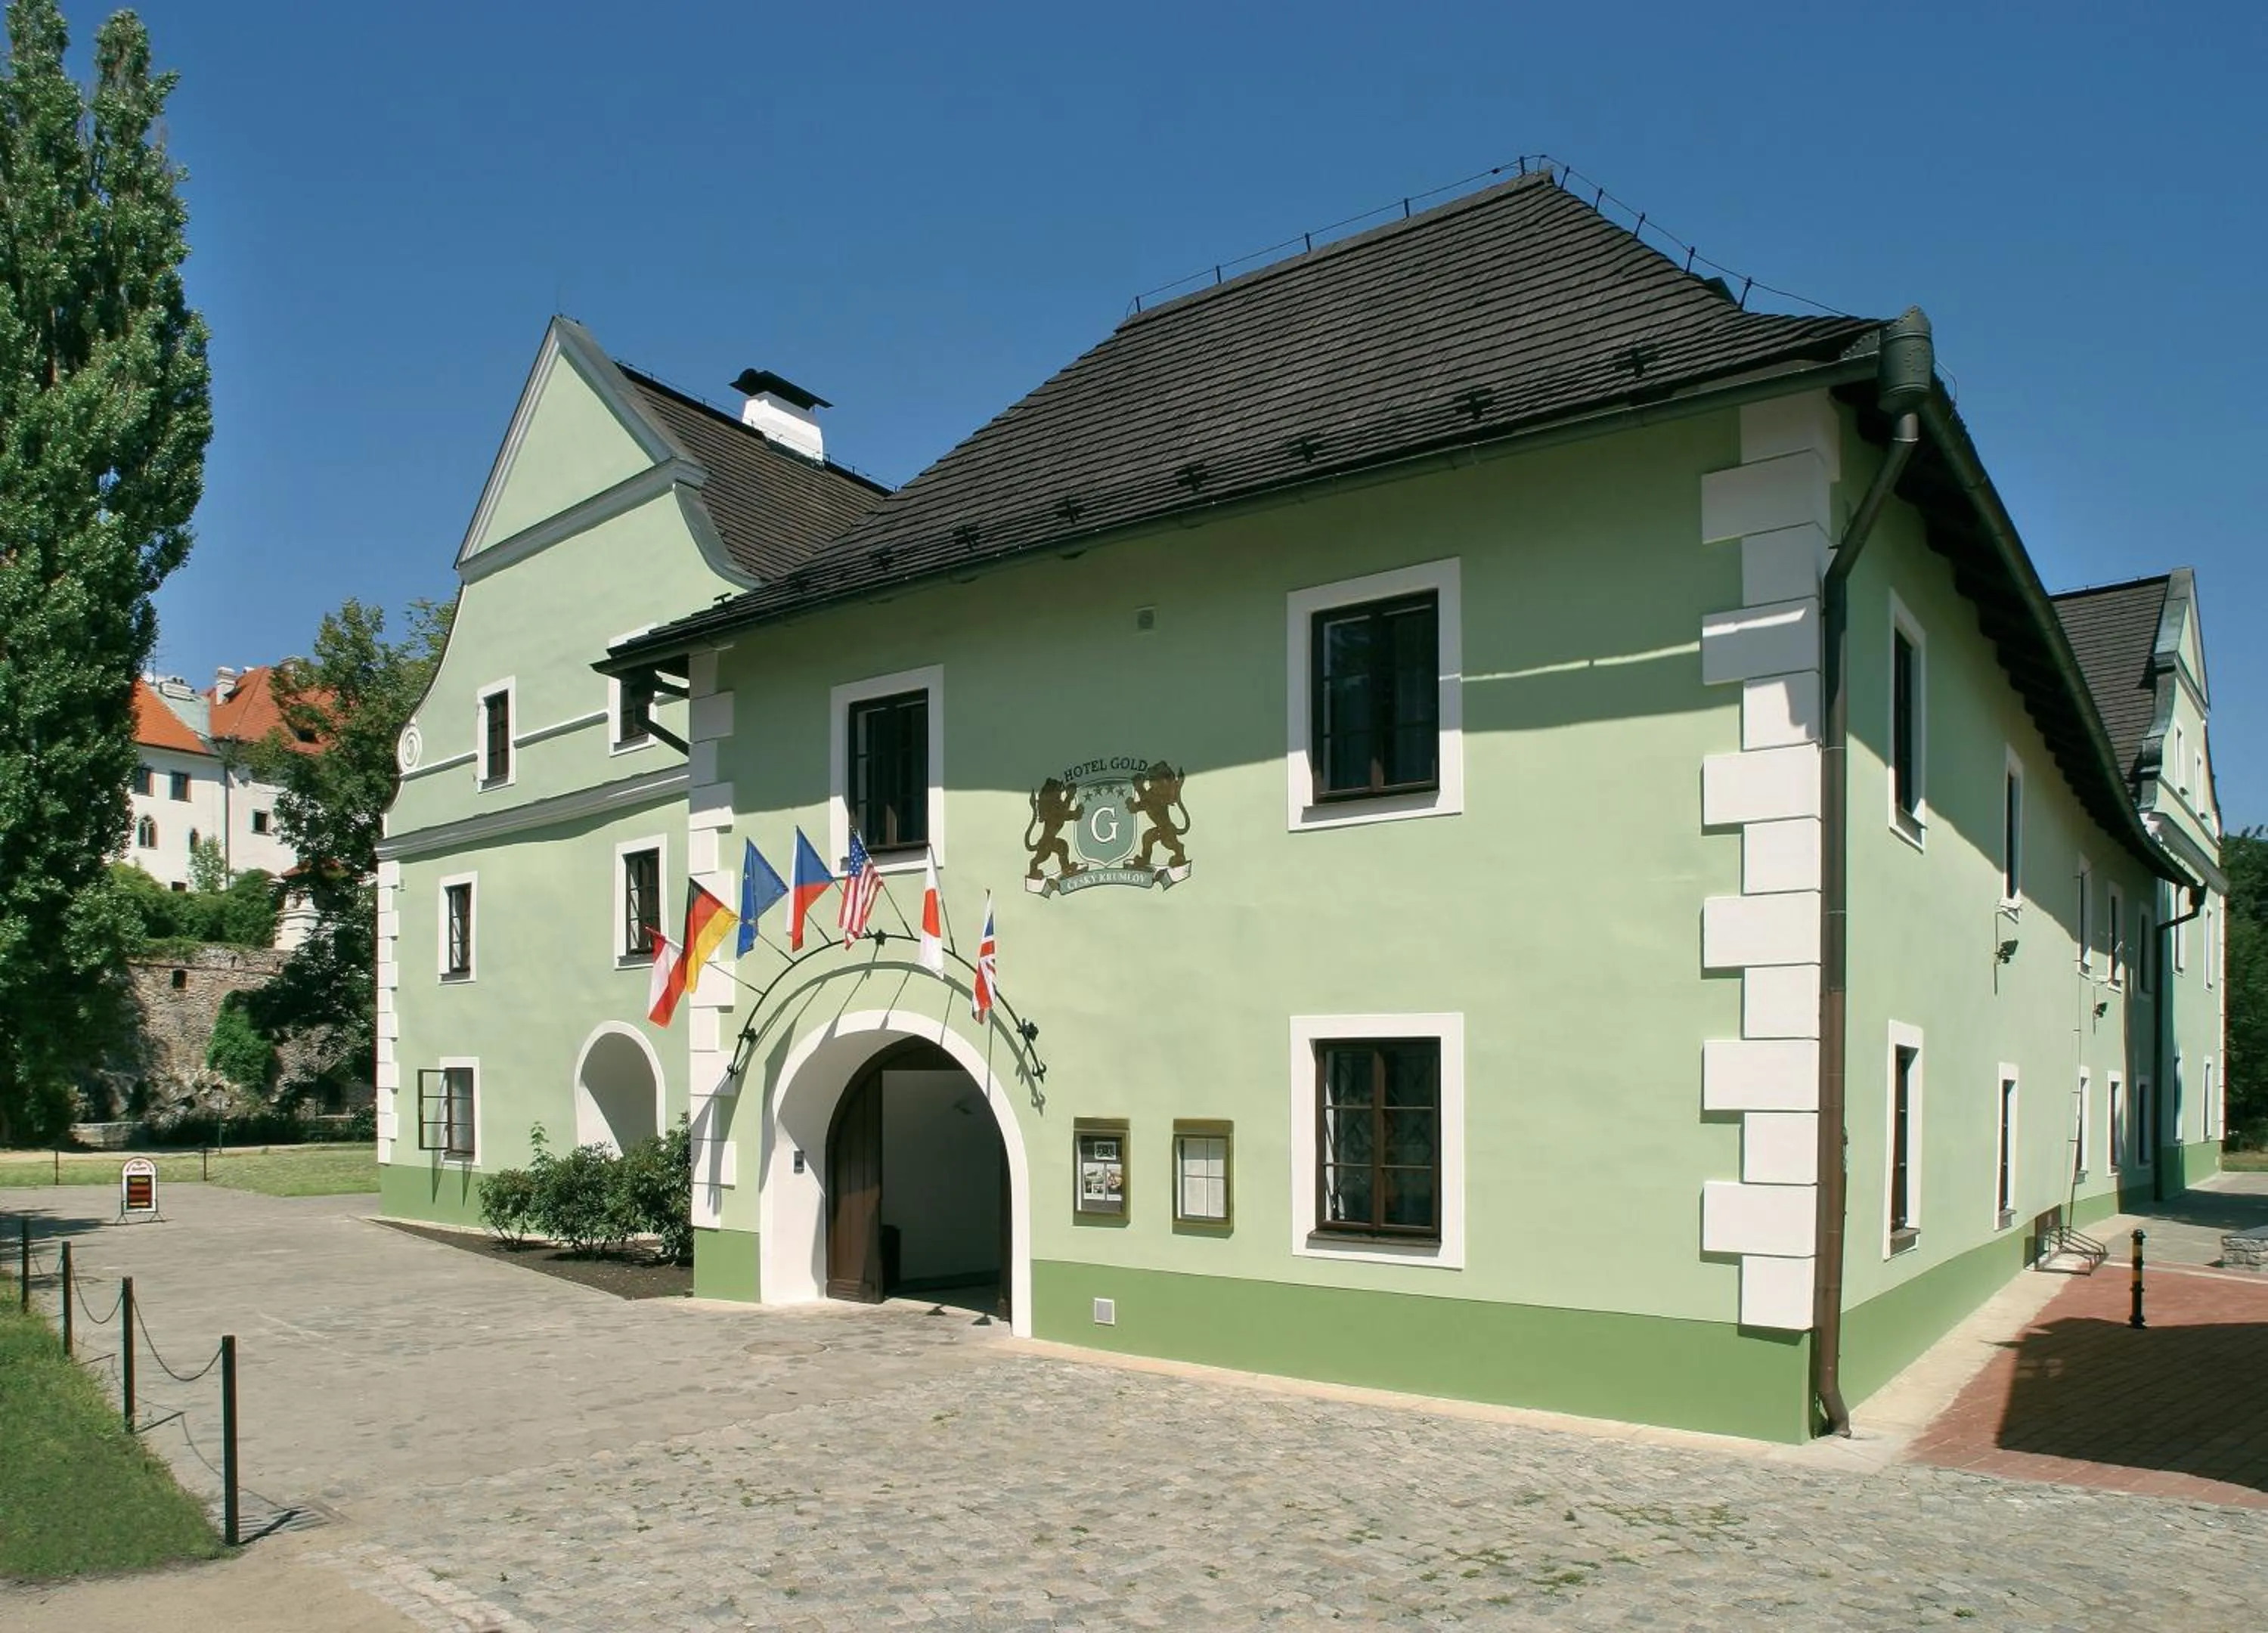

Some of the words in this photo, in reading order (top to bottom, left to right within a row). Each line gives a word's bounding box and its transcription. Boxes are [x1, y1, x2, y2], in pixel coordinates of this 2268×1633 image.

[1064, 759, 1107, 781] HOTEL
[1110, 757, 1148, 771] GOLD
[1091, 807, 1120, 843] G
